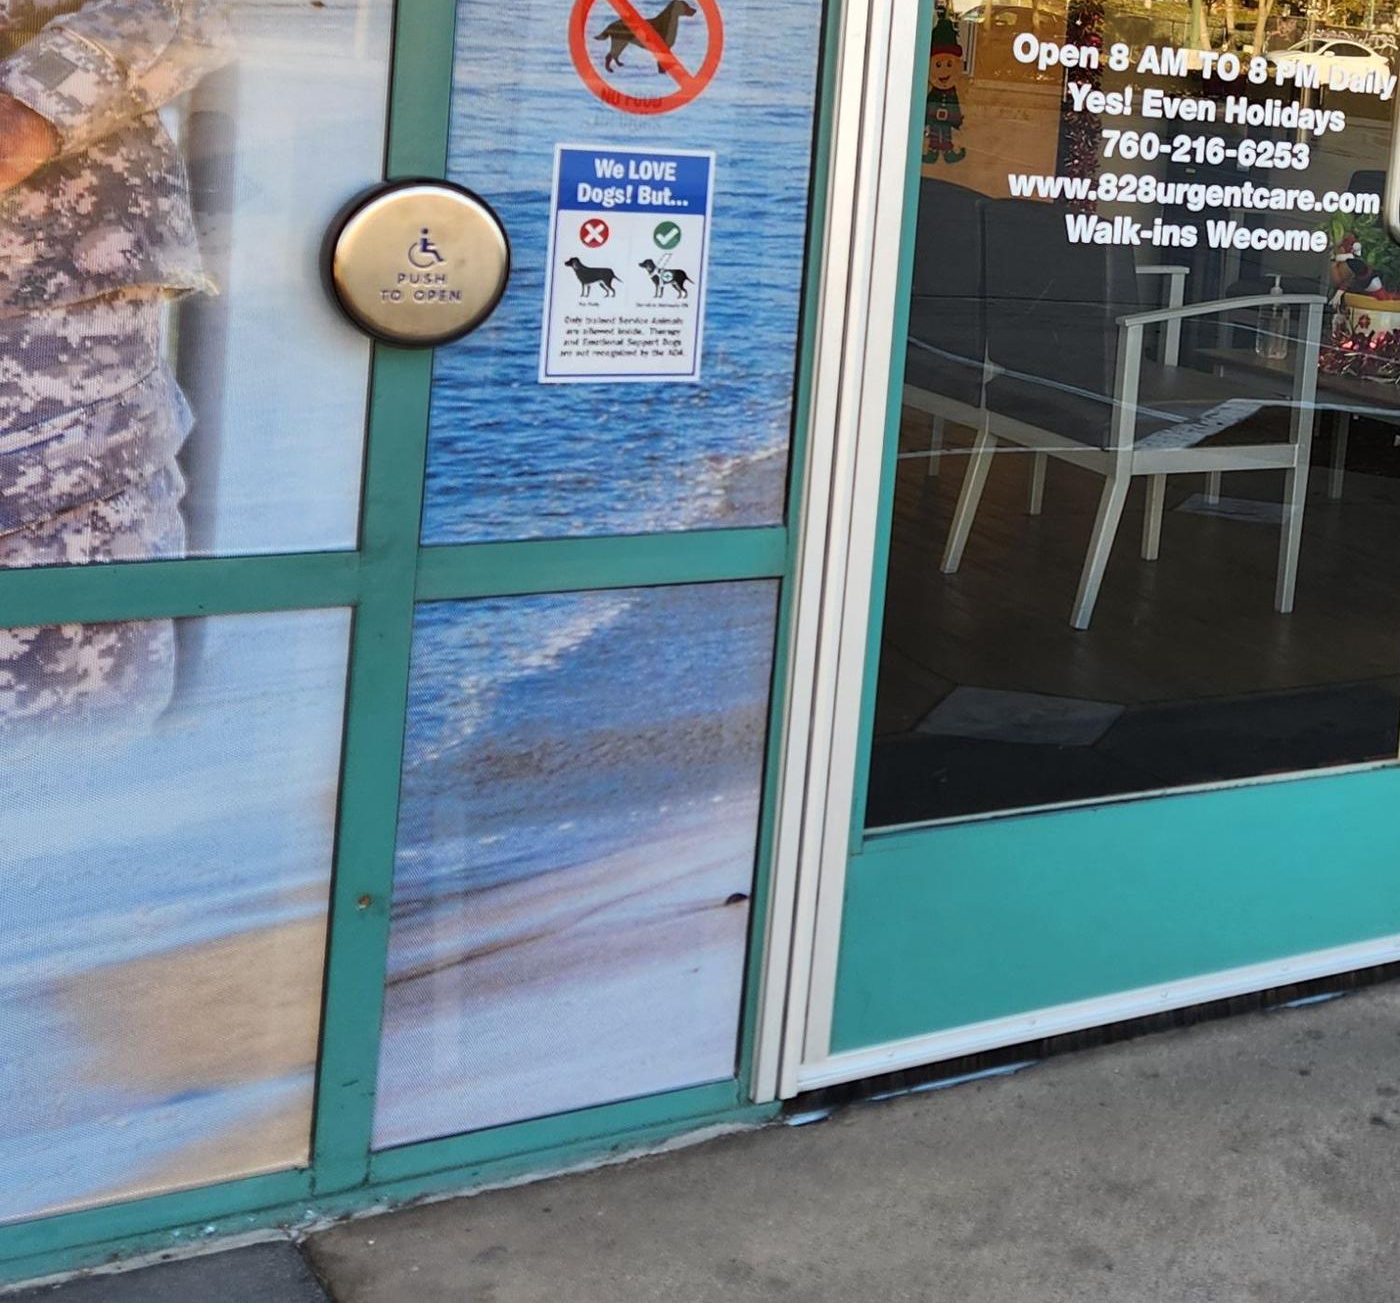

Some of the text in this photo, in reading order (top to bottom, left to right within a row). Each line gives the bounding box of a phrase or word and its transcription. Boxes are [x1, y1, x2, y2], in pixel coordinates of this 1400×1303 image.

[1013, 33, 1397, 101] Open 8 AM TO 8 PM Daily
[1068, 82, 1346, 136] Yes! Even Holidays
[594, 158, 678, 181] We LOVE
[1101, 129, 1310, 170] 760-216-6253
[577, 182, 689, 208] Dogs! But...
[1008, 173, 1381, 215] www.828urgentcare.com
[1065, 213, 1328, 253] Walk-ins Wecome
[380, 289, 463, 302] TO OPEN
[397, 272, 446, 284] PUSH
